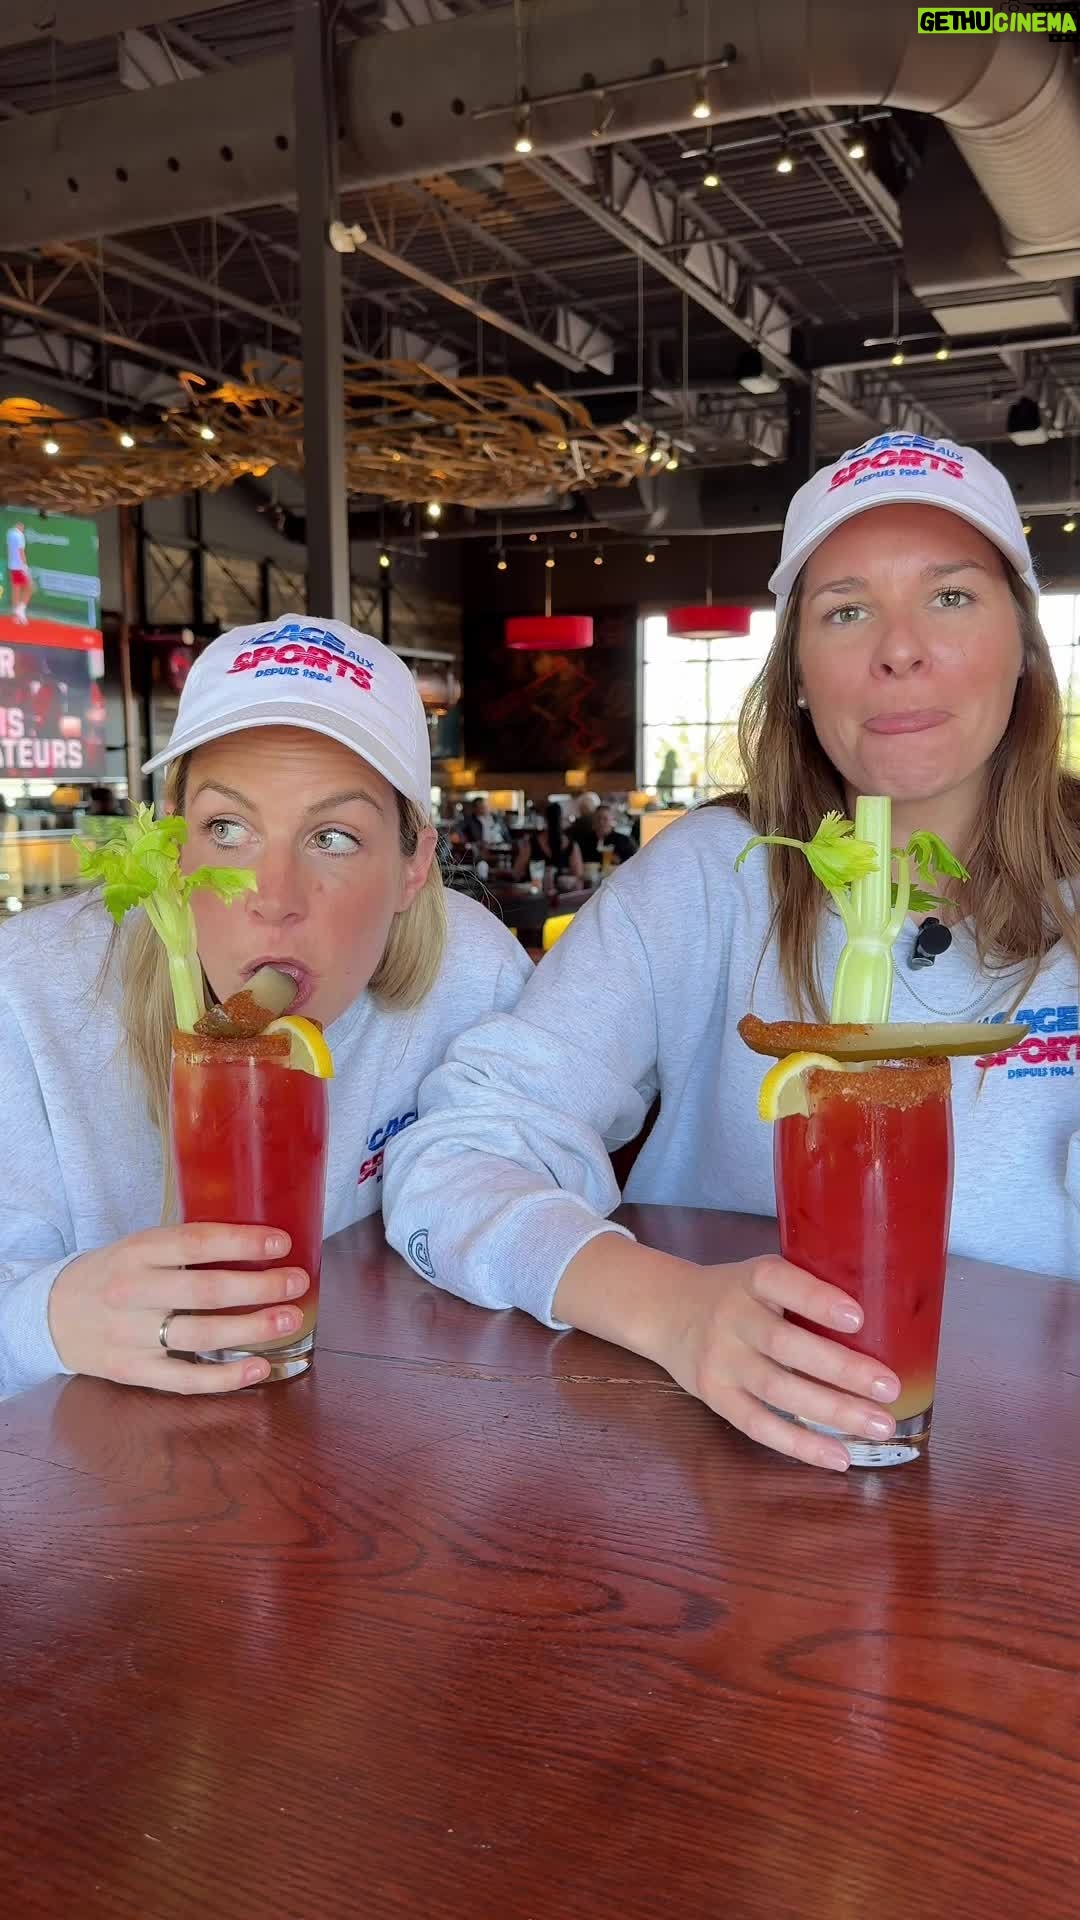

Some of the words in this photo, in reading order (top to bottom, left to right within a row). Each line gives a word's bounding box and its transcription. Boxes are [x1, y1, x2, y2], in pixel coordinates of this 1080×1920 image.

[847, 434, 936, 460] CAGE
[934, 446, 964, 462] AUX
[826, 448, 965, 494] SPORTS
[854, 468, 896, 487] DEPUIS
[899, 467, 928, 476] 1984
[251, 624, 347, 654] CAGE
[343, 650, 375, 671] AUX
[225, 643, 374, 691] SPORTS
[254, 666, 300, 679] DEPUIS
[303, 668, 333, 683] 1984
[0, 738, 83, 769] TEURS
[1049, 1066, 1075, 1077] 1984
[368, 1112, 417, 1151] CAG
